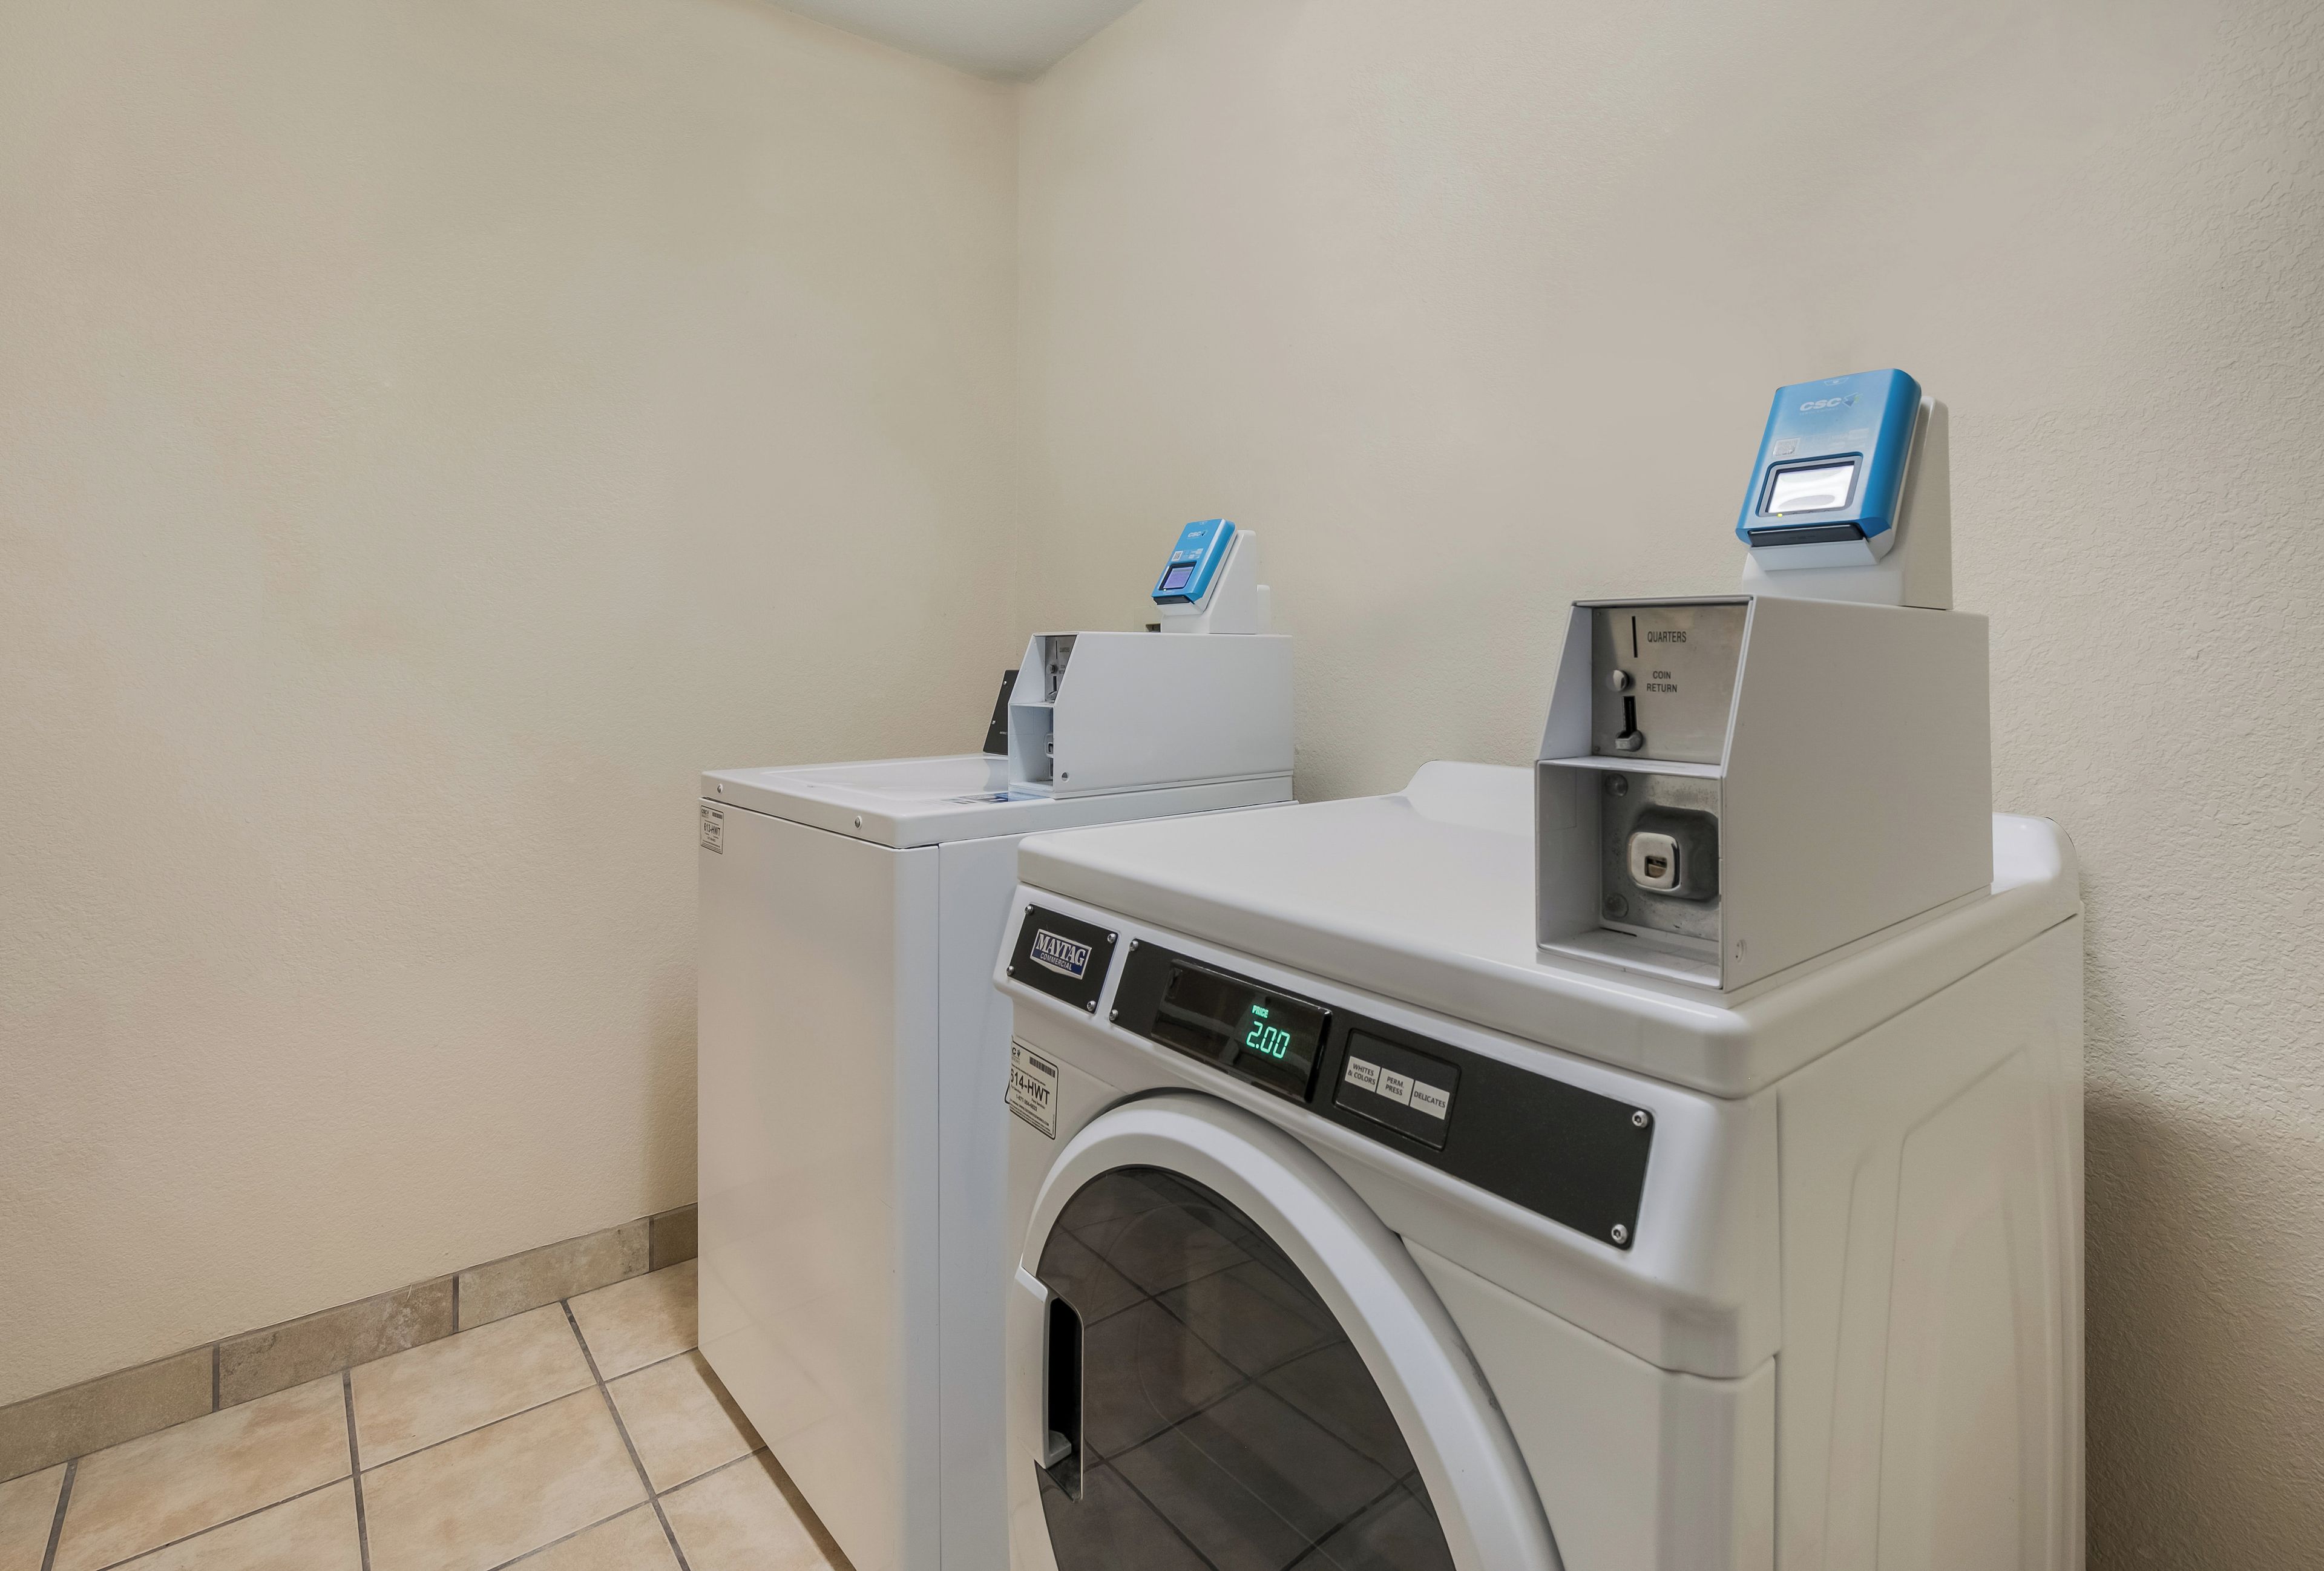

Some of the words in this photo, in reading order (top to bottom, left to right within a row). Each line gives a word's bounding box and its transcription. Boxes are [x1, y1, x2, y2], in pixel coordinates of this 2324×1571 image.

[1800, 397, 1842, 412] CSC
[1647, 631, 1687, 643] QUARTERS
[1653, 671, 1671, 679] COIN
[1647, 683, 1677, 693] RETURN
[1036, 934, 1086, 966] MAYTAG
[1040, 953, 1072, 971] COMMERCIAL
[1252, 1005, 1269, 1018] PRICE
[1246, 1020, 1290, 1058] 2.00
[1353, 1063, 1374, 1077] WHITES
[1354, 1072, 1376, 1086] COLORS
[1387, 1076, 1404, 1088] PERM.
[1385, 1084, 1403, 1096] PRESS
[1414, 1091, 1446, 1109] DELICATES
